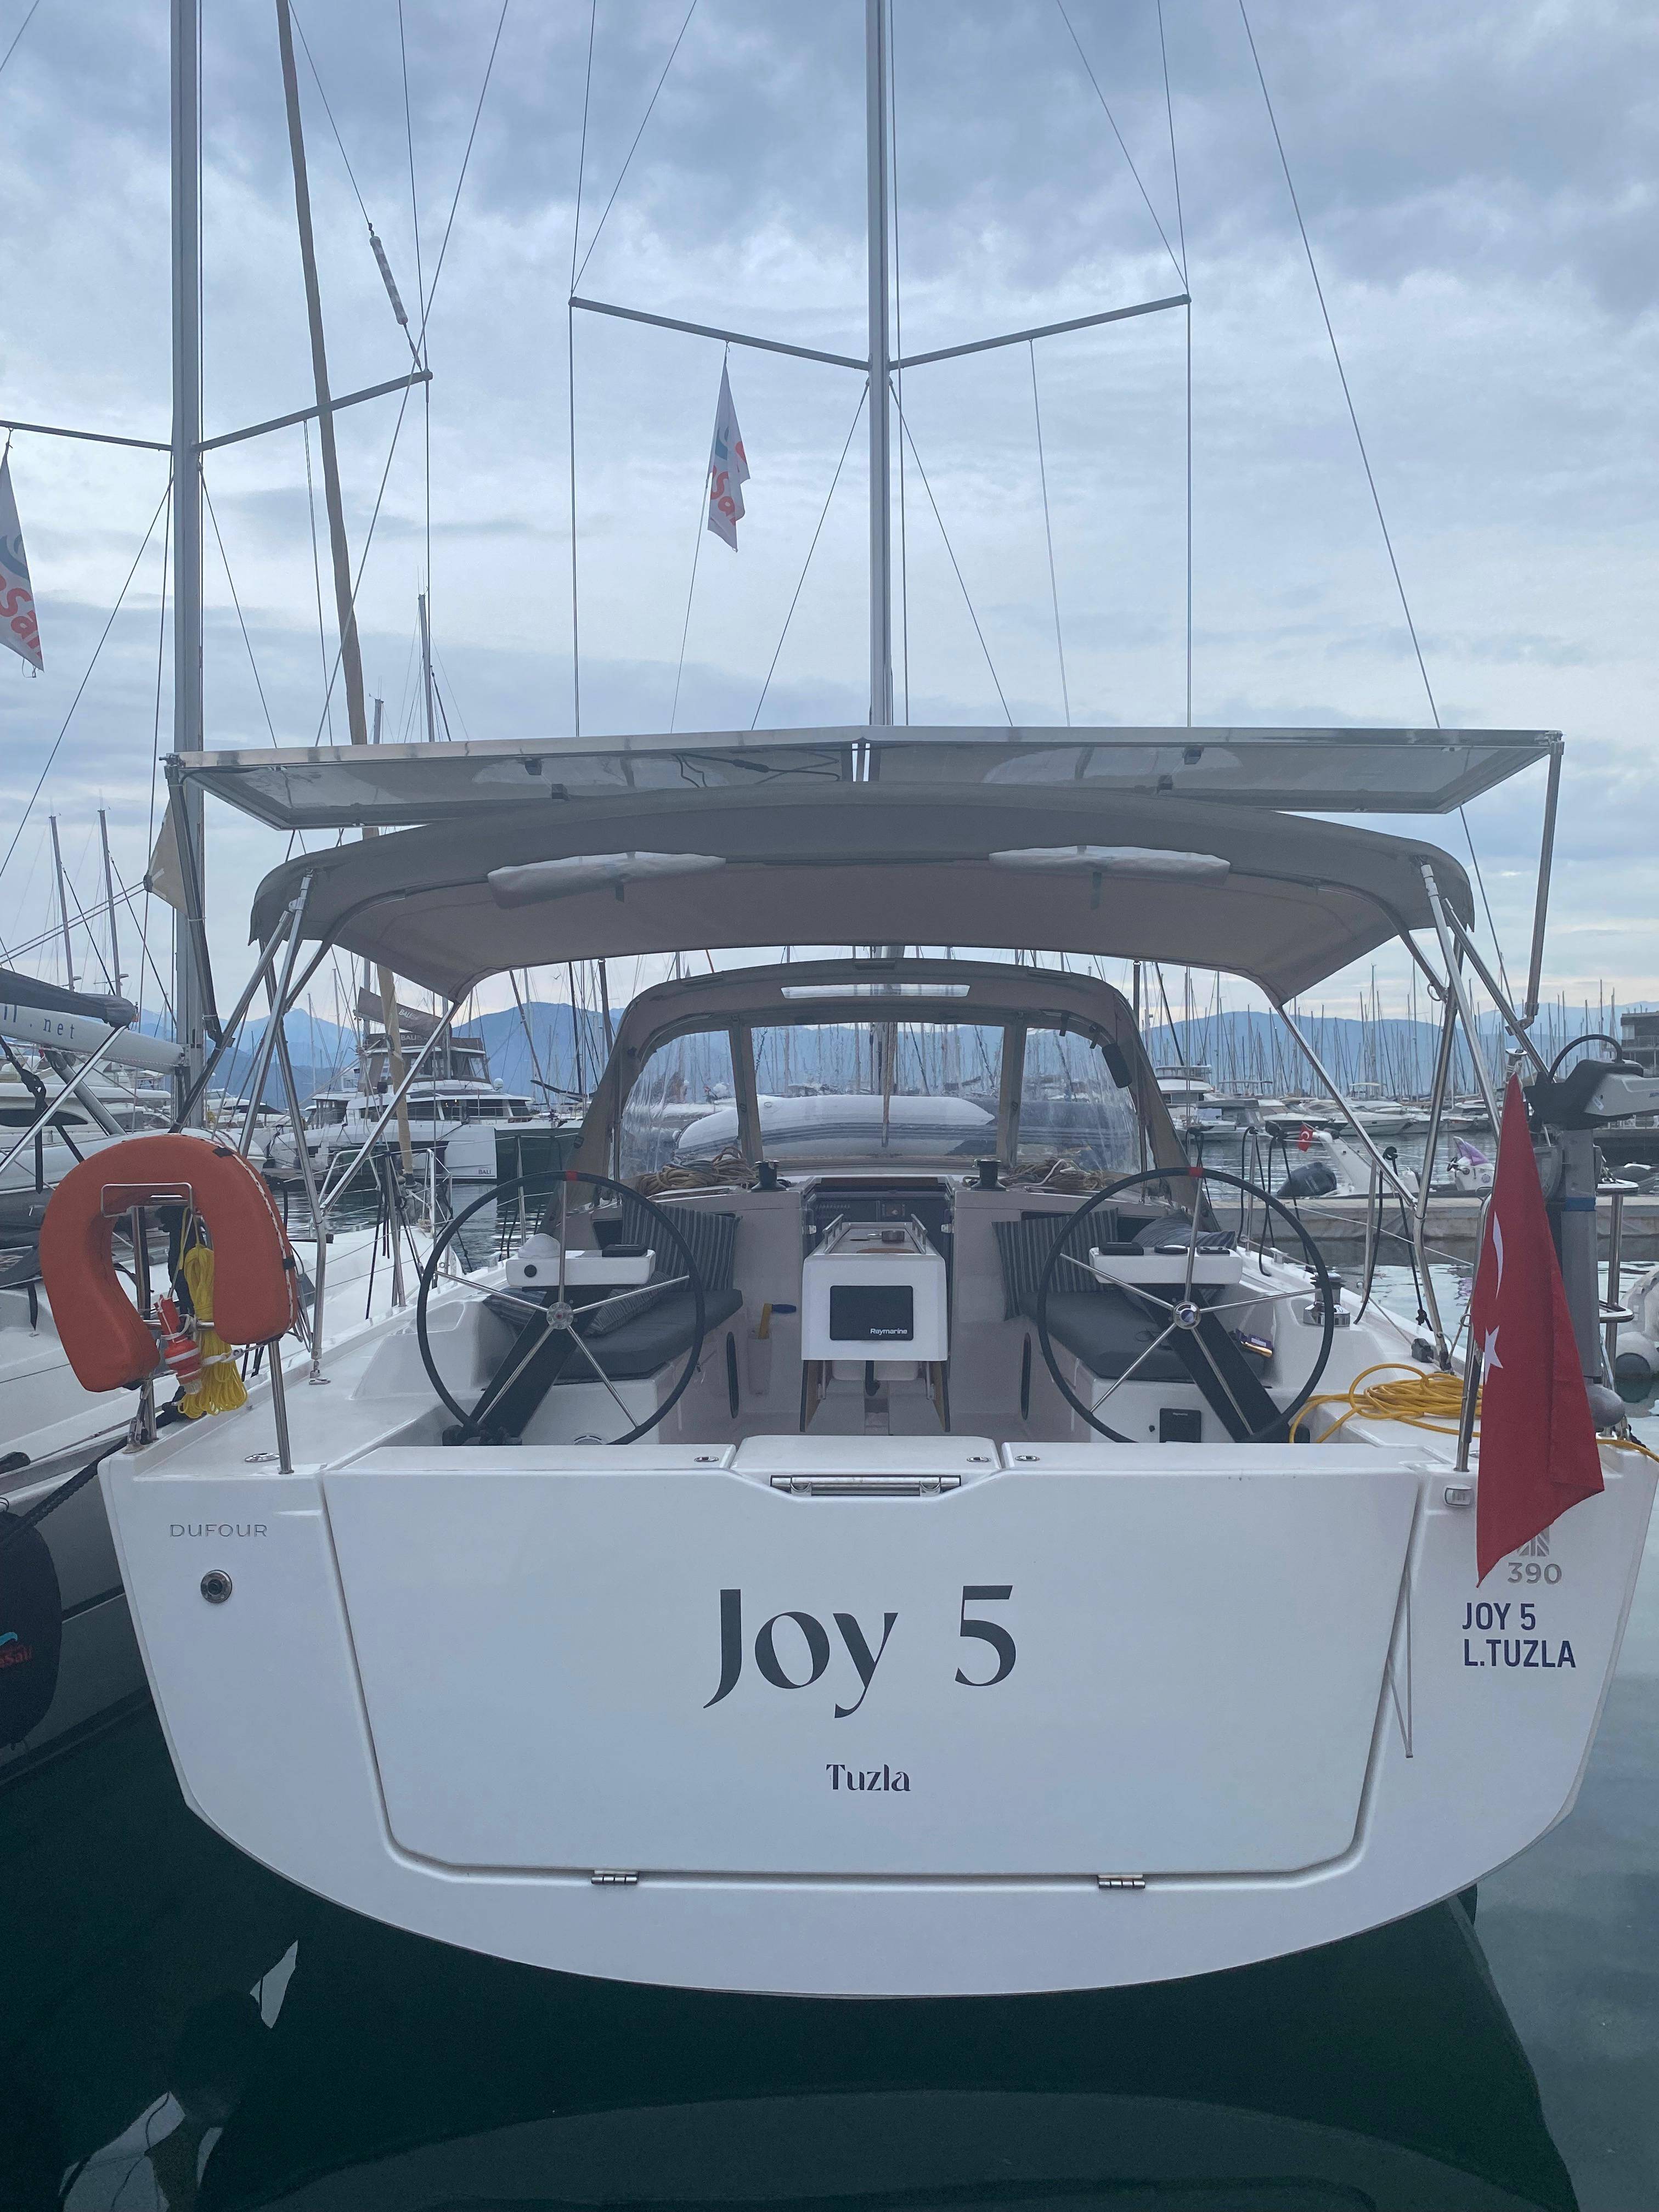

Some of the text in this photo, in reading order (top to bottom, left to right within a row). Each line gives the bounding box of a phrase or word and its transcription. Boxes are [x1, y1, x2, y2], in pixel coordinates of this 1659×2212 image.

[170, 1524, 267, 1537] DUFOUR
[1508, 1562, 1562, 1585] 390
[1462, 1602, 1536, 1630] JOY 5
[703, 1585, 1016, 1718] Joy 5
[1464, 1639, 1576, 1668] L.TUZLA
[826, 1764, 911, 1792] Tuzla
